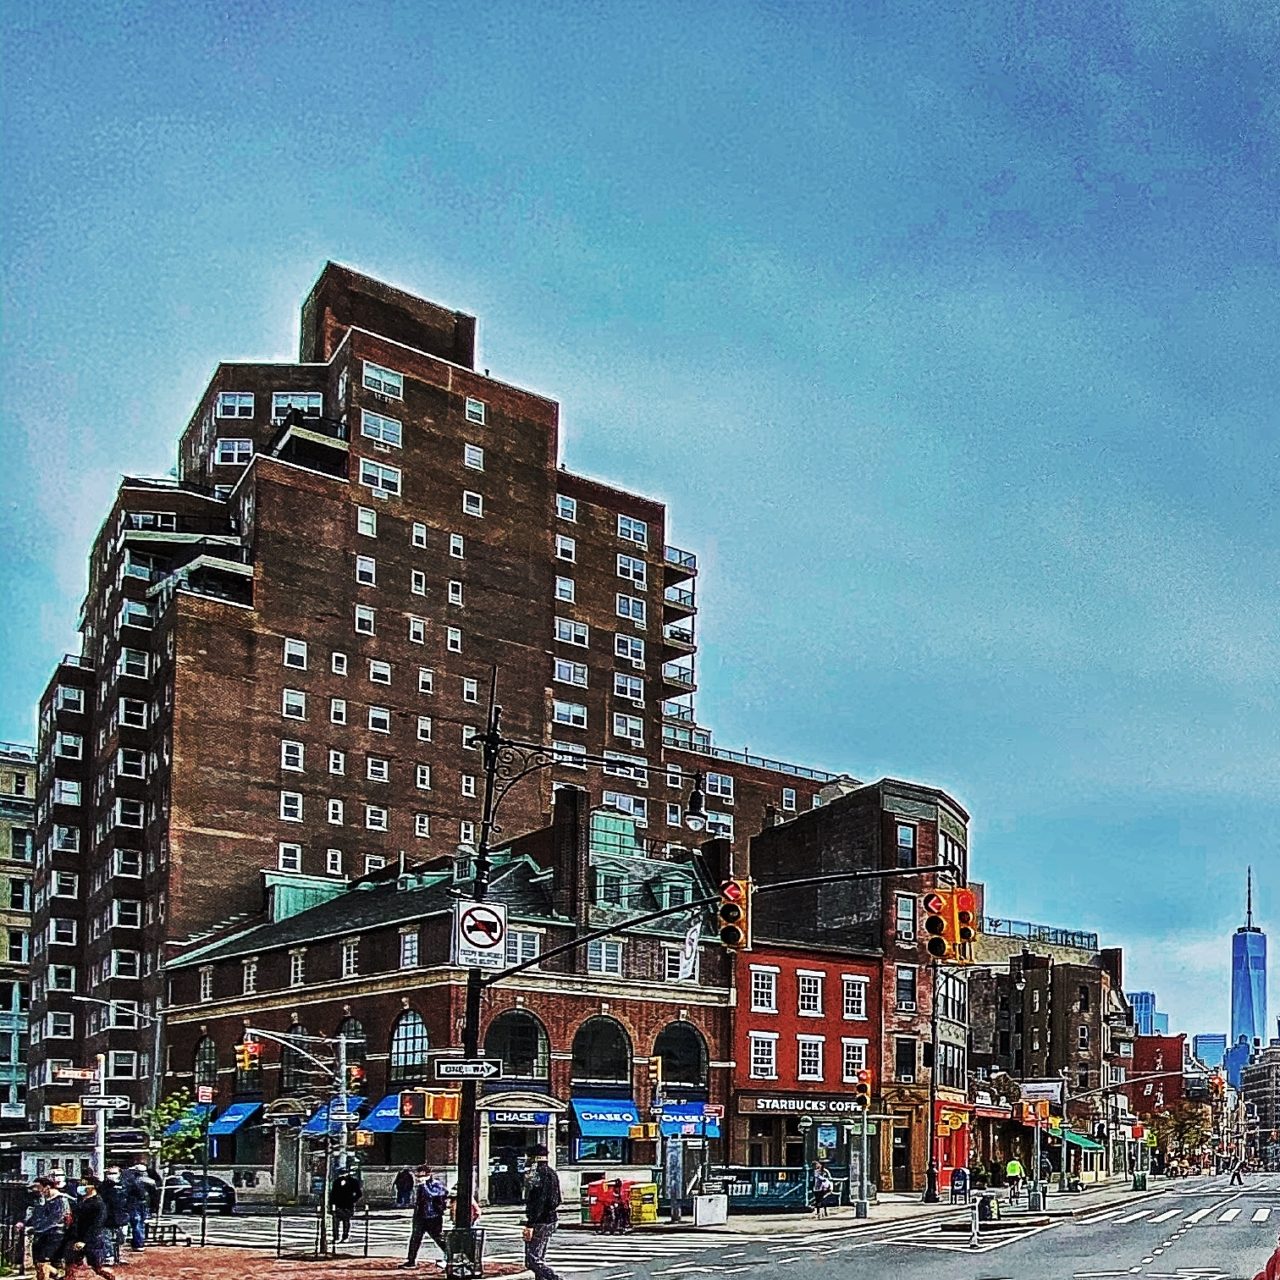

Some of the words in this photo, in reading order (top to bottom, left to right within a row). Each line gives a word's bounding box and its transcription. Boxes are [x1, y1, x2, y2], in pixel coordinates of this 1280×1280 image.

[445, 1065, 465, 1074] ONE
[472, 1065, 492, 1074] WAY
[756, 1099, 826, 1111] STARBUCKS
[495, 1112, 535, 1121] CHASE
[581, 1112, 622, 1121] CHASE
[661, 1114, 699, 1123] CHASE
